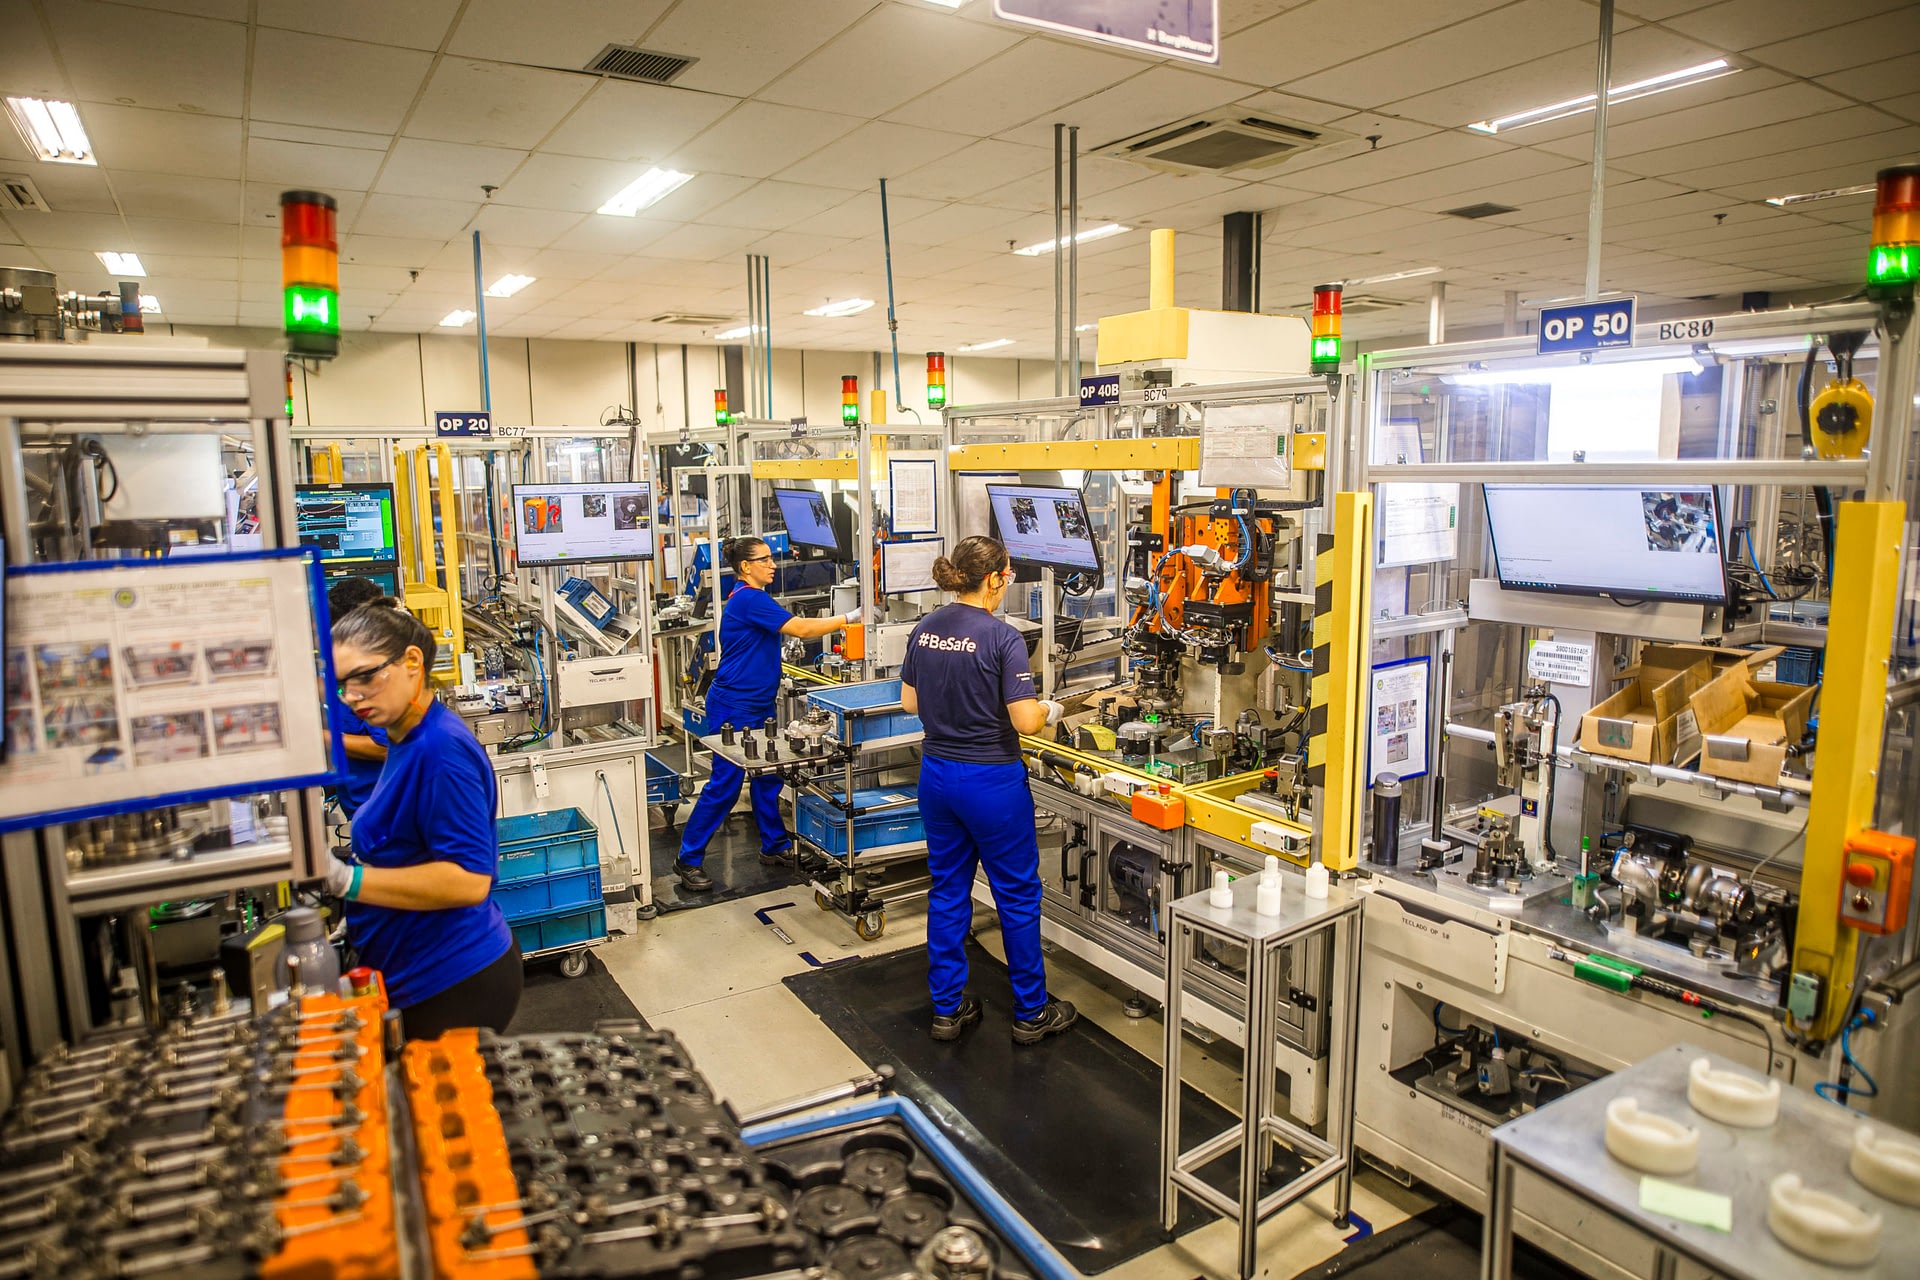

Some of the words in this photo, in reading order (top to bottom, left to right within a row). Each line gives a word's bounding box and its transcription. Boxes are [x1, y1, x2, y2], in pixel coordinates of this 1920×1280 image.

[1544, 319, 1584, 341] OP
[1592, 312, 1629, 337] 50
[1660, 319, 1714, 341] BC80
[1080, 386, 1096, 399] OP
[1097, 383, 1119, 398] 40B
[1144, 388, 1168, 402] BC79
[439, 418, 463, 431] OP
[468, 418, 489, 431] 20
[498, 427, 526, 436] BC77
[918, 632, 977, 652] #BeSafe
[1402, 917, 1428, 931] TECLADO
